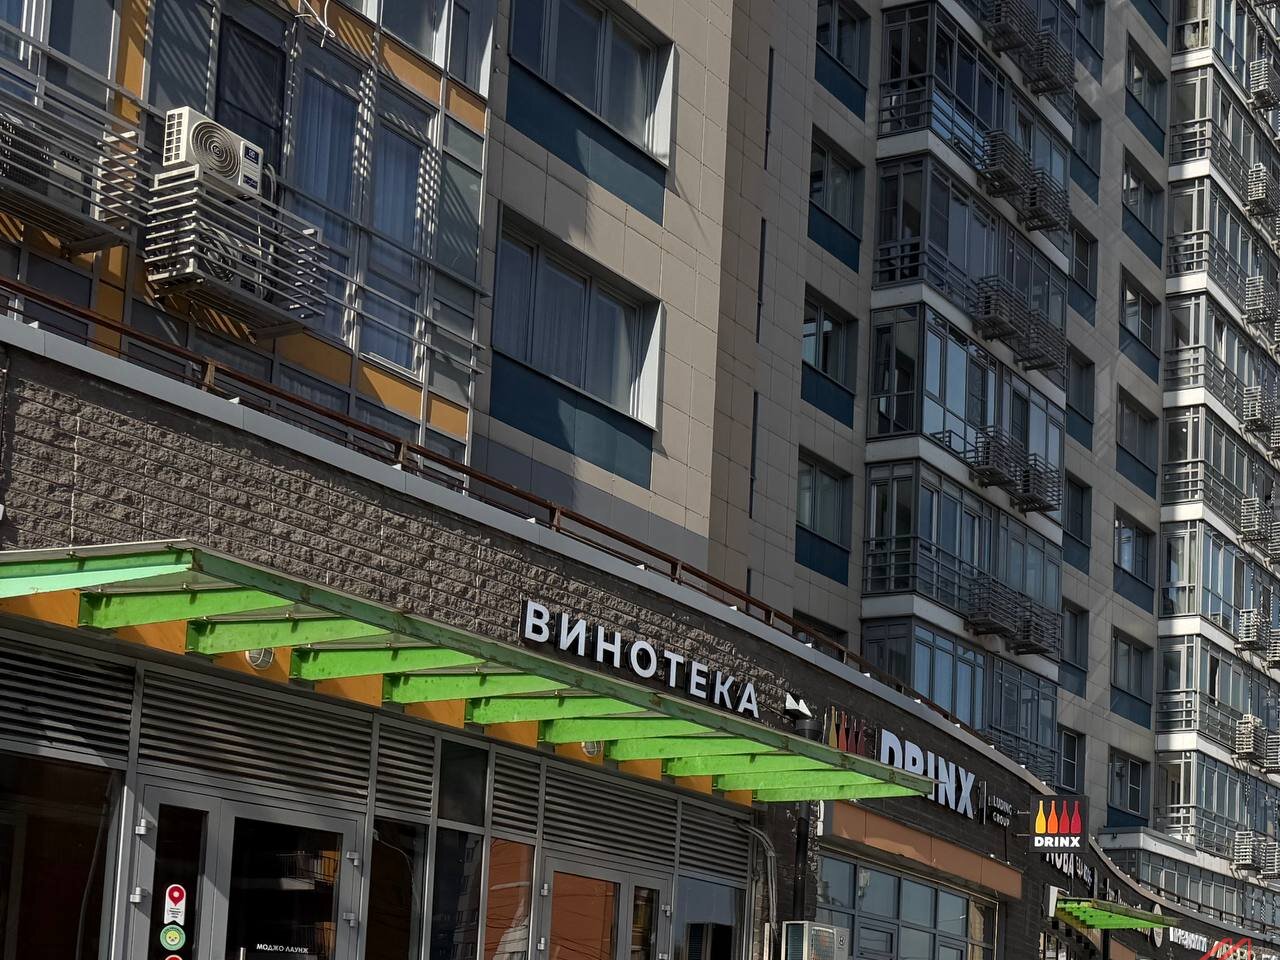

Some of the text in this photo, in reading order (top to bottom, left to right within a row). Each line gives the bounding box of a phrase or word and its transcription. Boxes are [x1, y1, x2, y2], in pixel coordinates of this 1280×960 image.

[524, 600, 760, 718] ВИНОТЕКА
[880, 728, 976, 820] DRINX
[1034, 836, 1080, 847] DRINX
[285, 946, 309, 954] ЛАУНЖ
